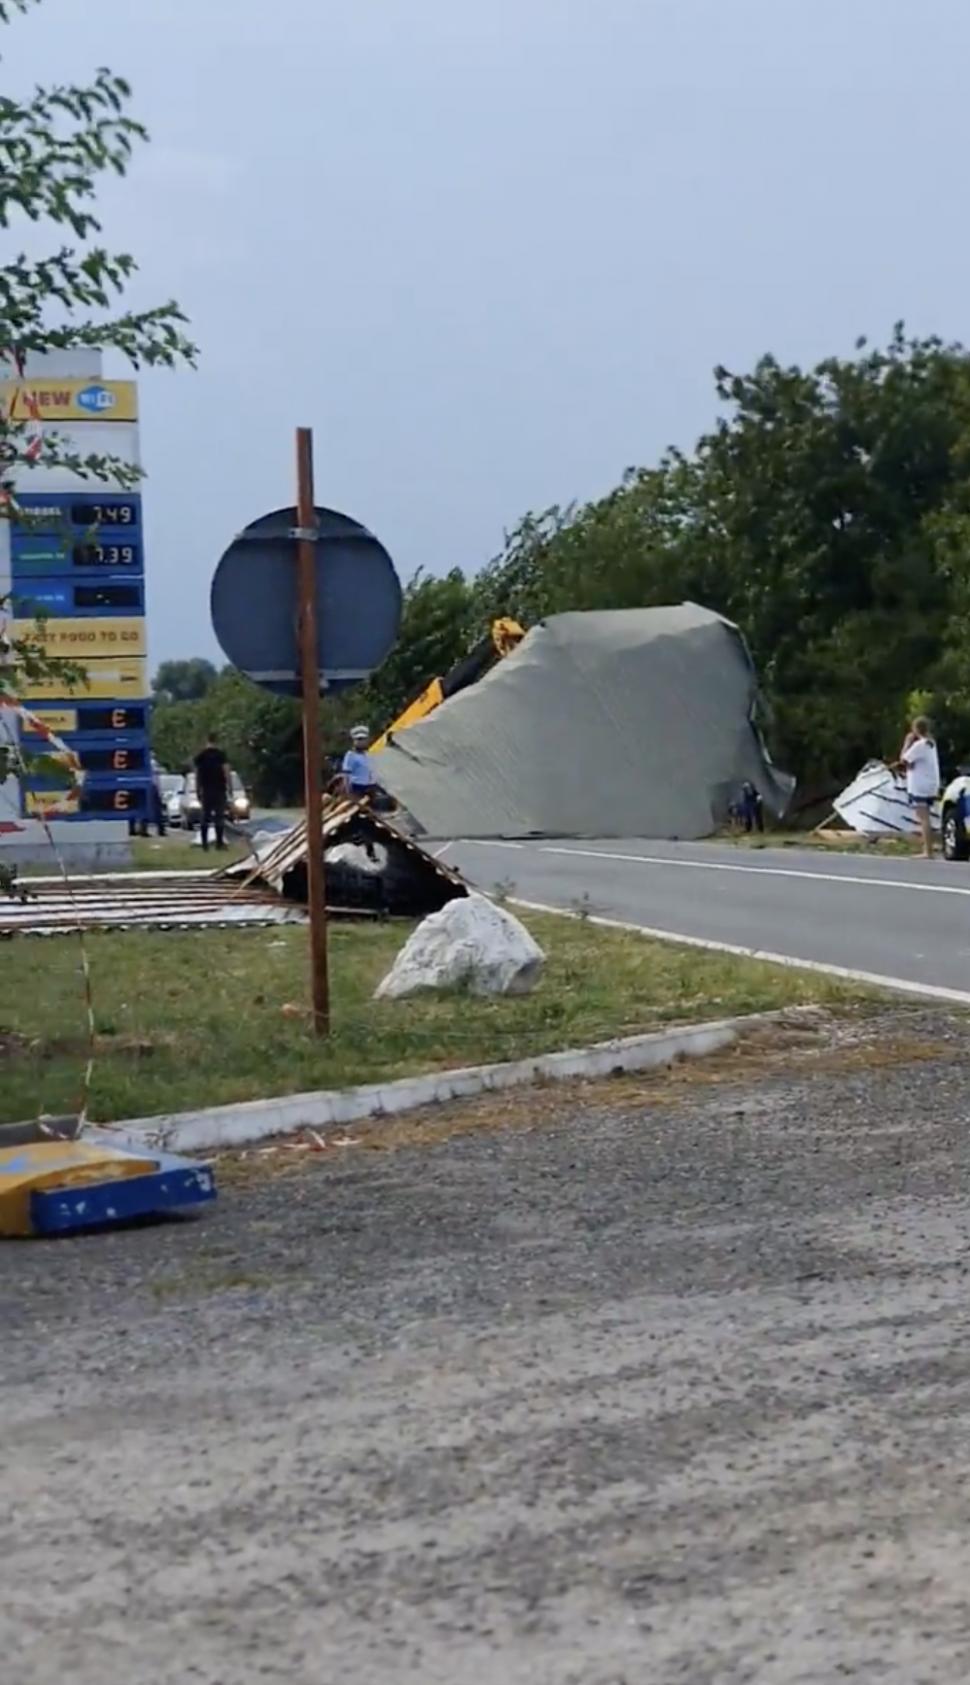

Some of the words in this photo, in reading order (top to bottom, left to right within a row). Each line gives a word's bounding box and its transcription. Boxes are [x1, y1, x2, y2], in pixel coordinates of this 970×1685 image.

[22, 391, 71, 406] NEW
[100, 631, 117, 640] TO
[120, 631, 139, 640] GO
[112, 709, 126, 728] E
[113, 750, 128, 769] E
[114, 790, 129, 809] E
